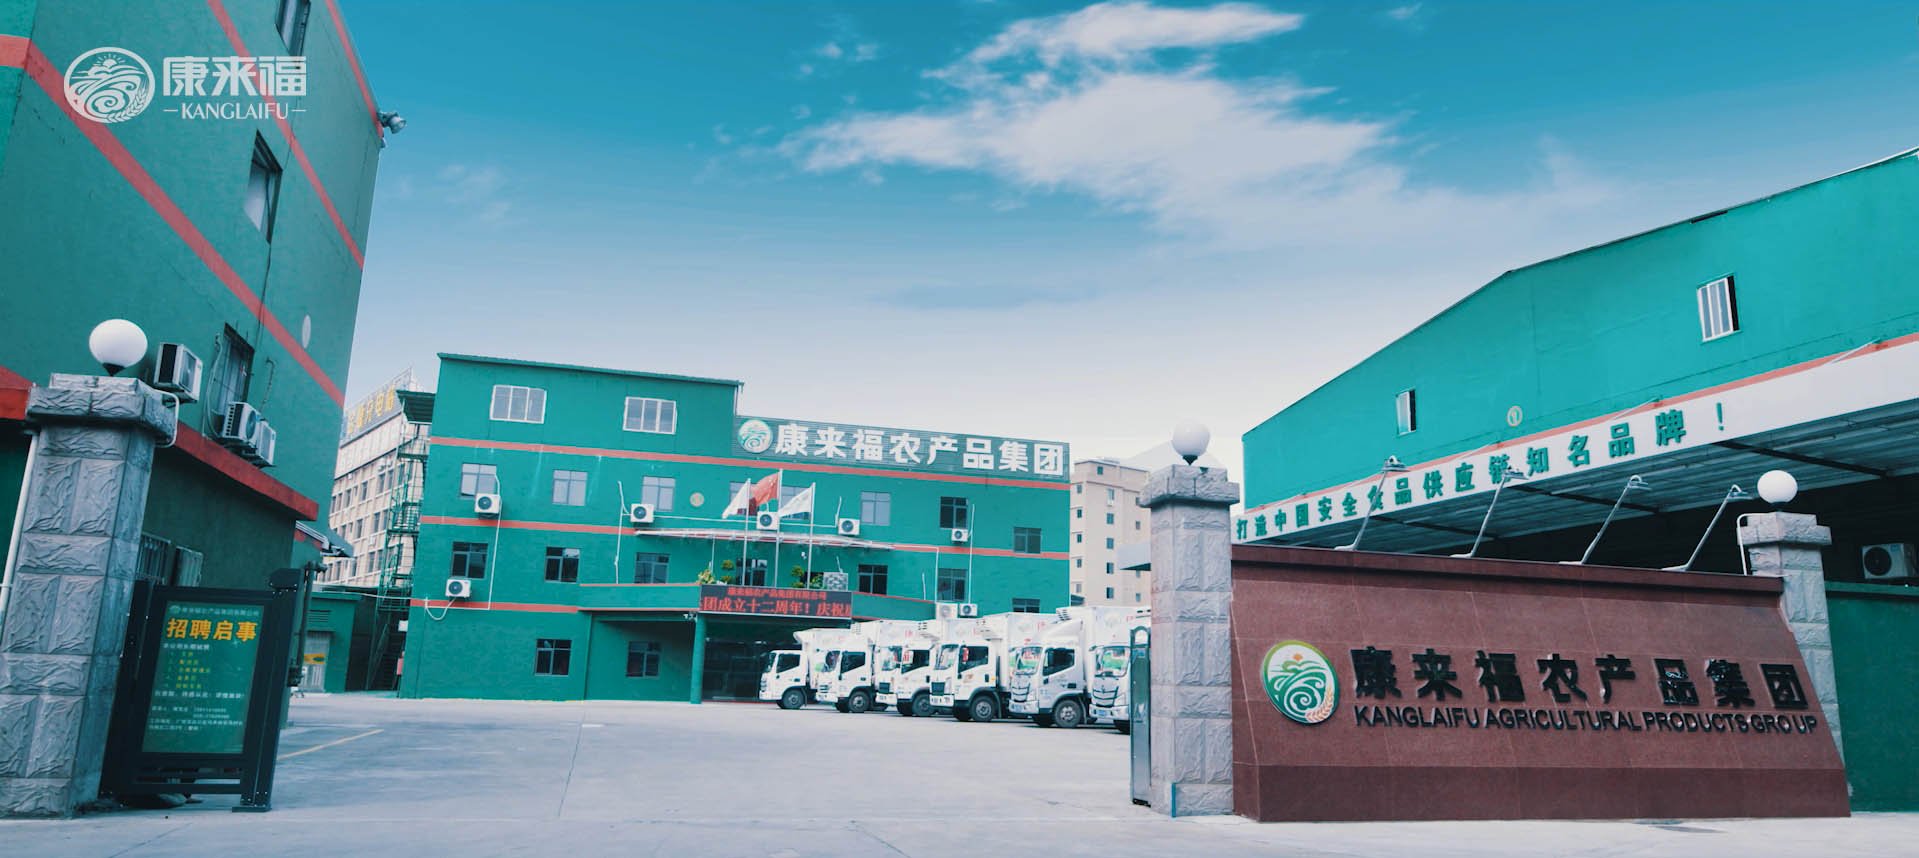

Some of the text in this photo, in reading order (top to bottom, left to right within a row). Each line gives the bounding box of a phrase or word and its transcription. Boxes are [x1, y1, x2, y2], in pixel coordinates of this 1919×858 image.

[775, 422, 1065, 477] 康来福农产品集团
[165, 617, 259, 643] 招聘启事
[1349, 645, 1809, 710] 康来福农产品集团
[1353, 705, 1481, 729] KANGLAIFU
[1483, 707, 1642, 732] AGRICULTURAL
[1640, 711, 1749, 734] PRODUCTS
